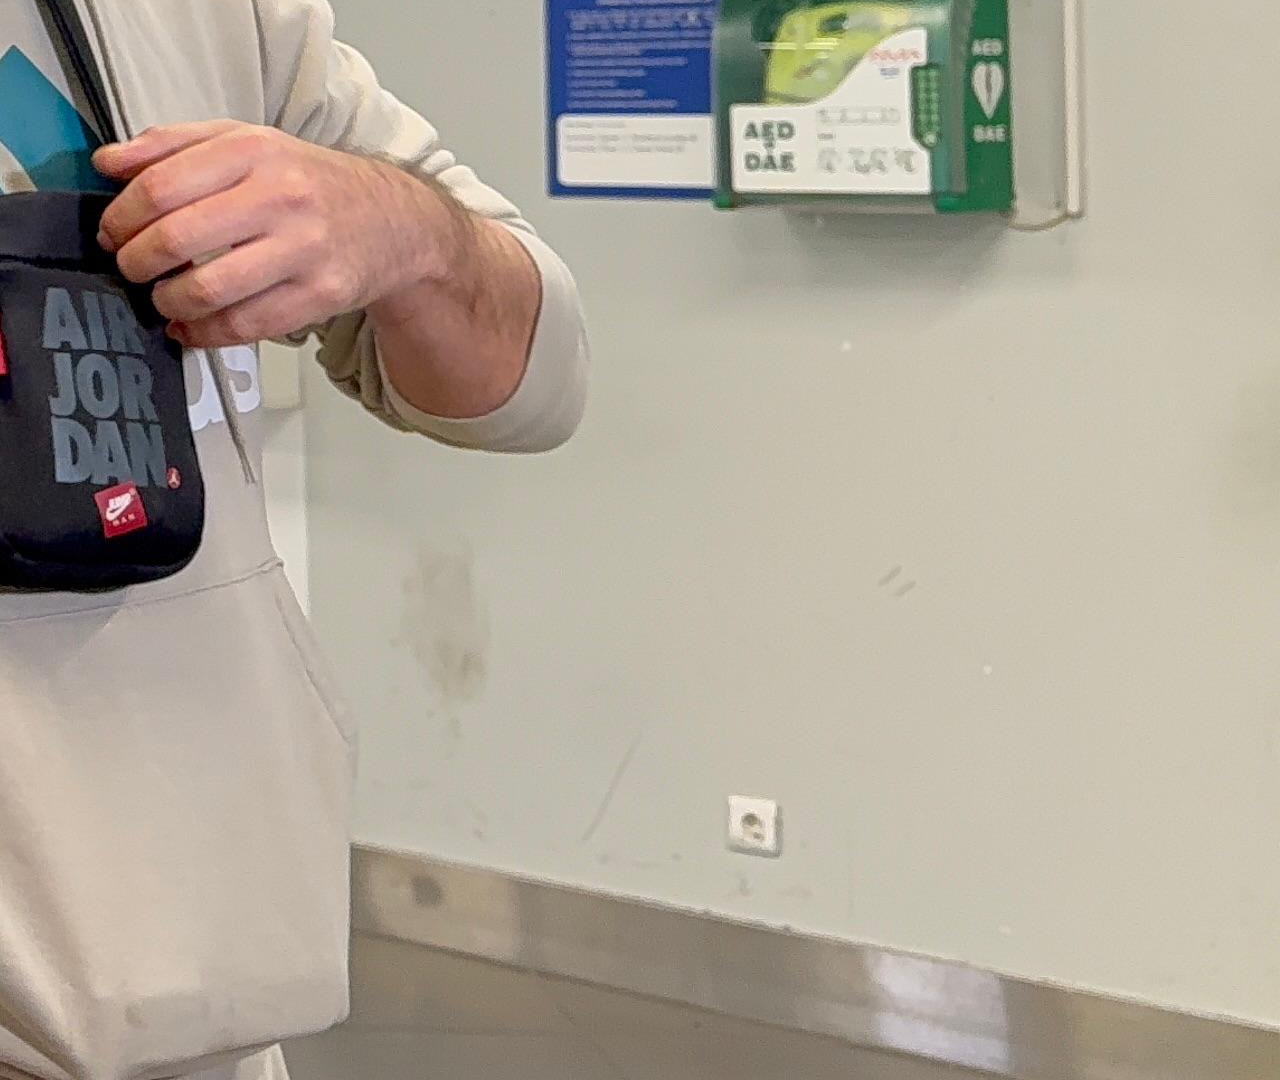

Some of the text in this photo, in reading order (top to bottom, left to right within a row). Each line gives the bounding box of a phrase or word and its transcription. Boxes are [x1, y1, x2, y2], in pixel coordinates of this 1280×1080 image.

[744, 121, 795, 140] AED
[744, 151, 796, 171] DAE
[41, 287, 146, 355] AIR
[48, 352, 159, 419] JOR
[51, 415, 169, 488] DAN
